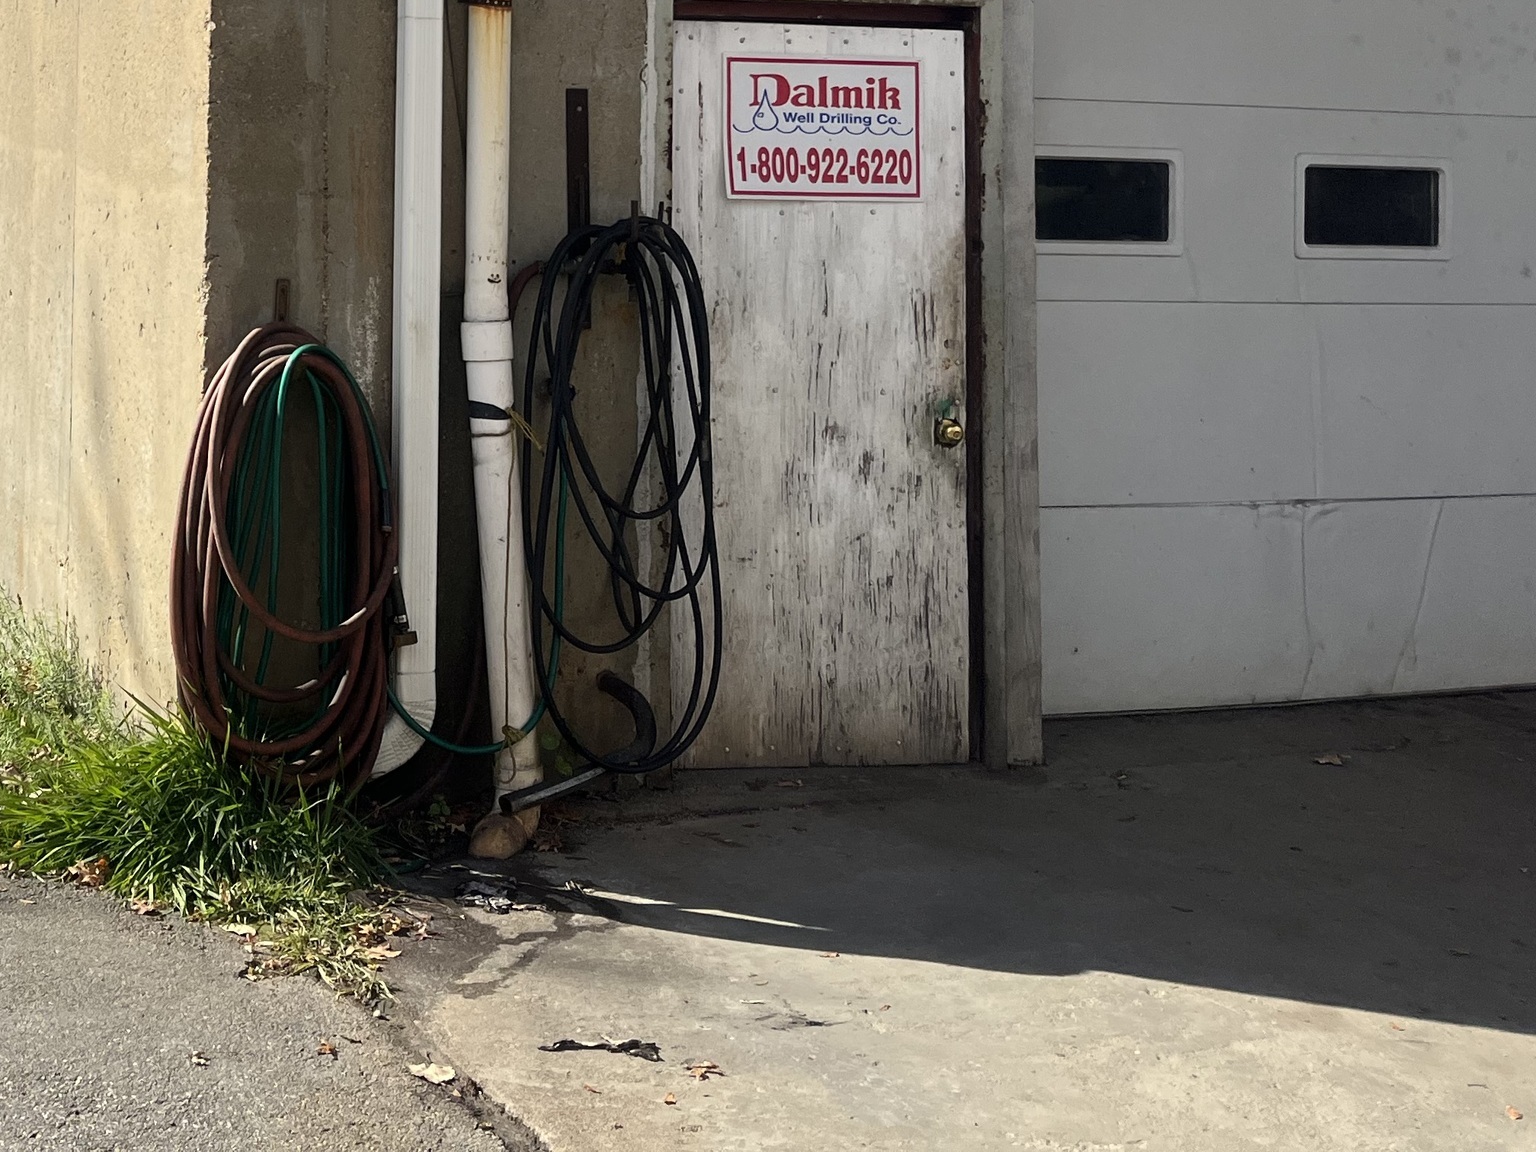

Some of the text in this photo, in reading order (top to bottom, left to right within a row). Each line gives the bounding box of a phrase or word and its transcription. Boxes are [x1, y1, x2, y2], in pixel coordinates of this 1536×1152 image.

[749, 73, 902, 110] Dalmik
[783, 112, 902, 126] Well Drilling Co.
[737, 146, 913, 185] 1-800-922-6220
